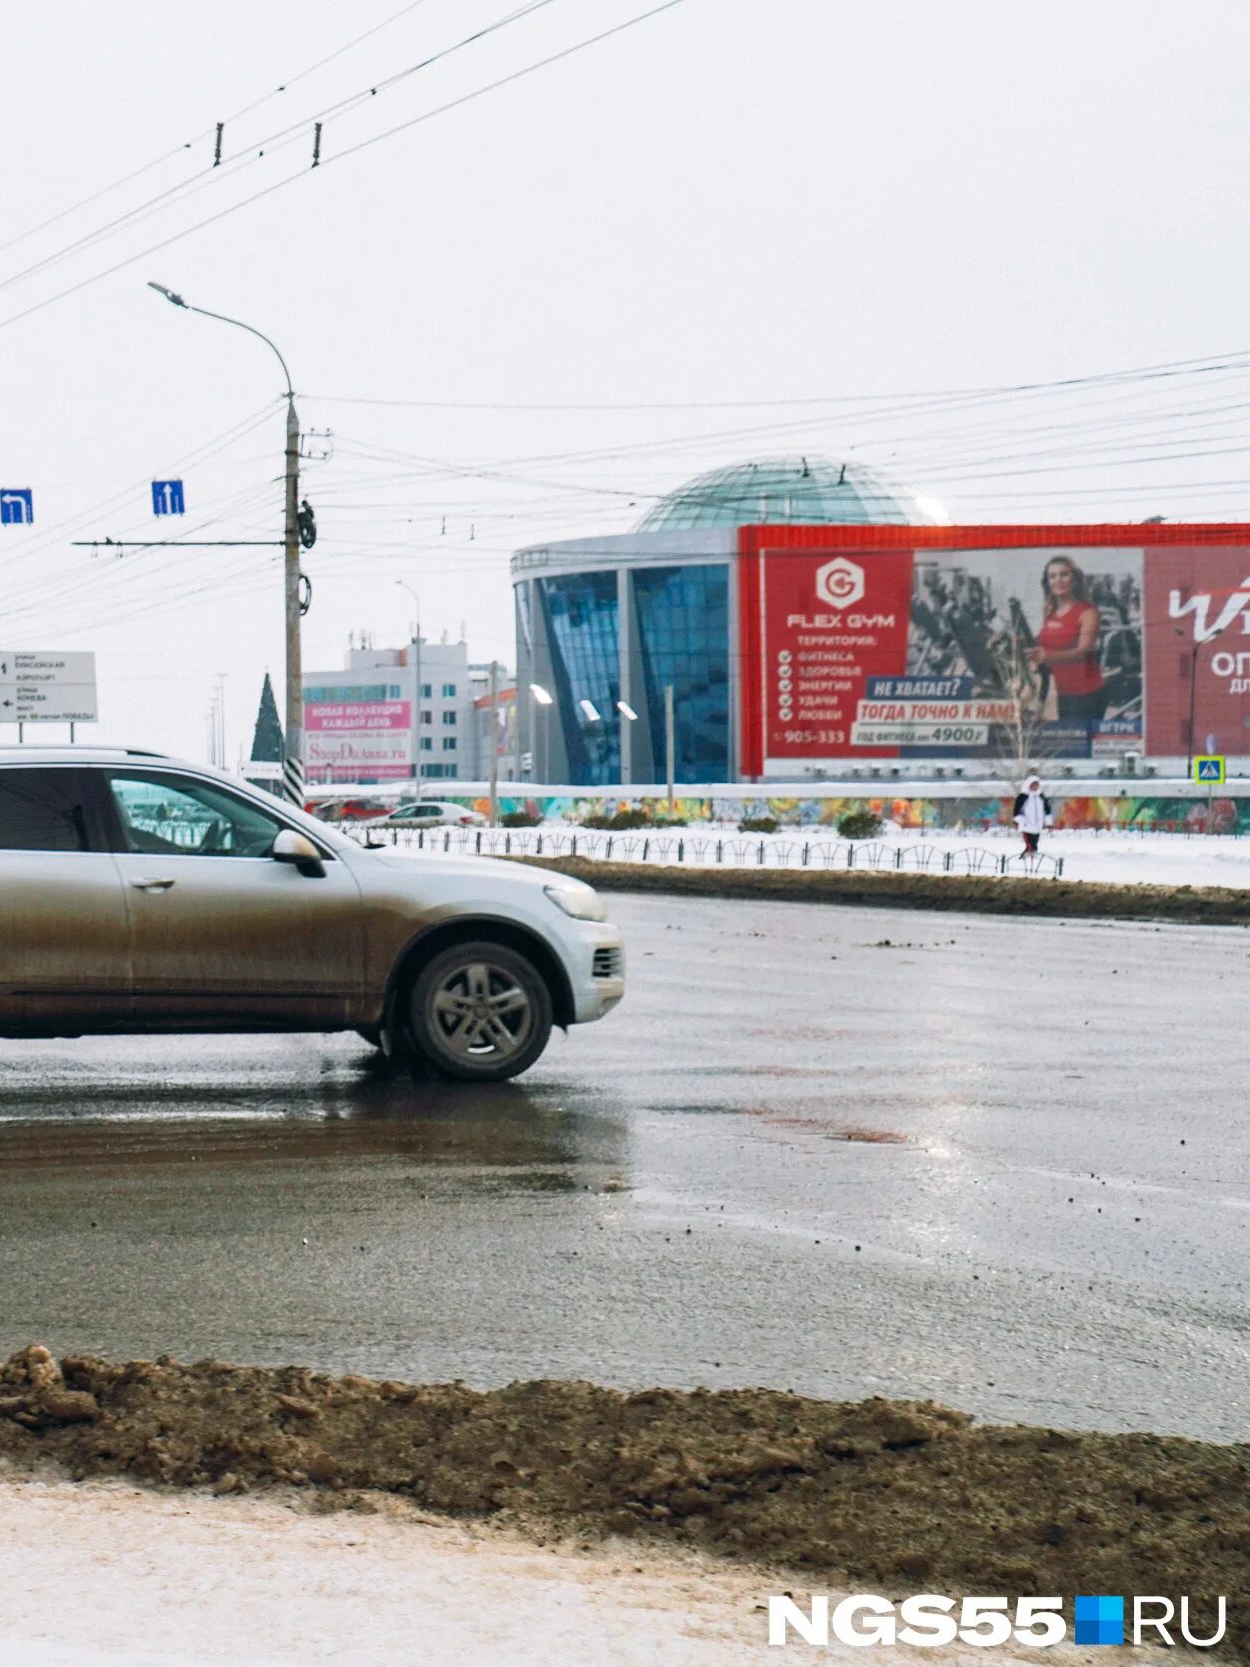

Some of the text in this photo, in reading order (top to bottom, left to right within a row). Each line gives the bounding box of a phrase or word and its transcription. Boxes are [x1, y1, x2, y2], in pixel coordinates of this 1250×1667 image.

[787, 614, 895, 628] FLEX GYM
[874, 679, 961, 696] НЕ ХВАТАЕТ?
[798, 696, 839, 706] УДАЧИ
[861, 704, 905, 720] ТОГДА
[910, 704, 958, 720] ТОЧНО
[962, 704, 972, 719] К
[785, 731, 845, 744] 905-333
